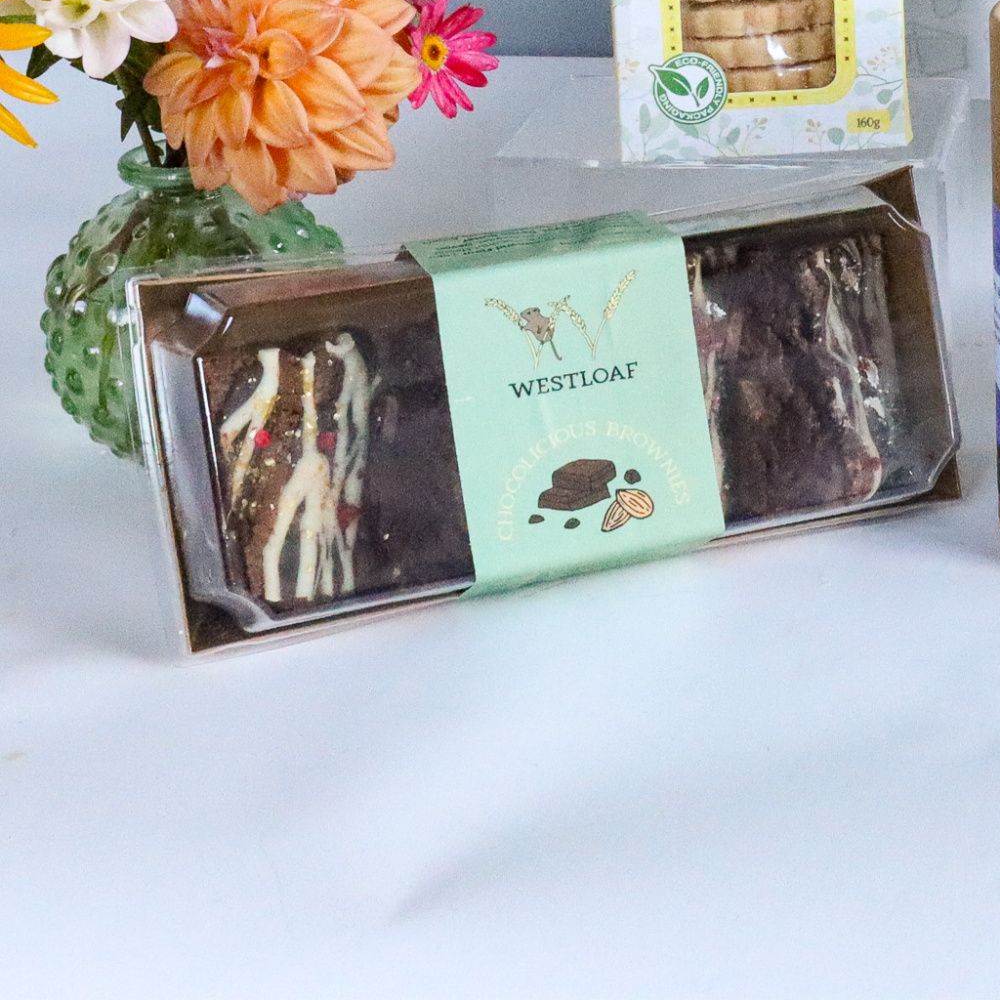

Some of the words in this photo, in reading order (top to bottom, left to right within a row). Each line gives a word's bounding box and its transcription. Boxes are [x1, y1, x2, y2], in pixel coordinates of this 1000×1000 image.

[857, 117, 881, 130] 160g
[508, 362, 639, 399] WESTLOAF
[497, 420, 597, 542] CHOCOLICIOUS
[606, 420, 692, 506] BROWNIES
